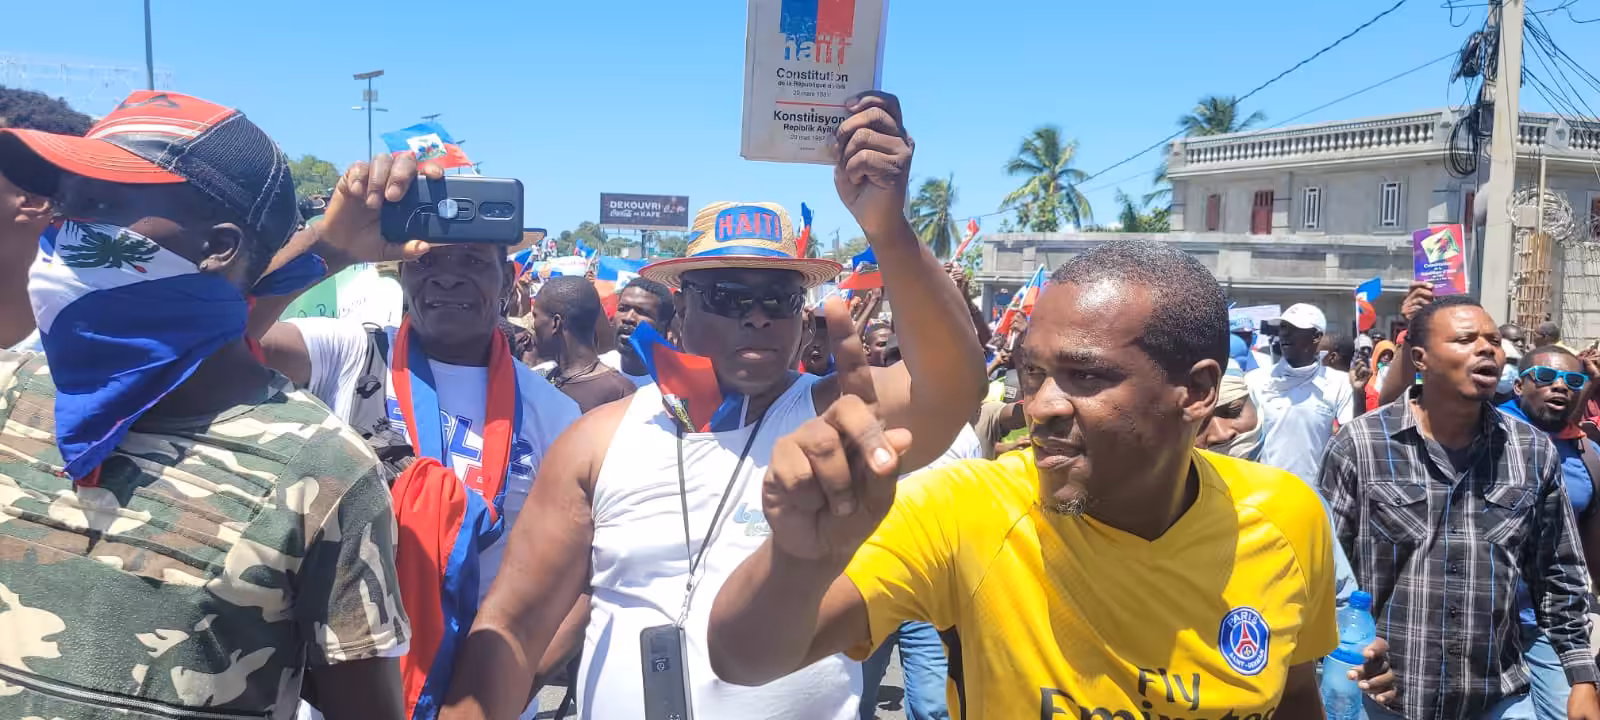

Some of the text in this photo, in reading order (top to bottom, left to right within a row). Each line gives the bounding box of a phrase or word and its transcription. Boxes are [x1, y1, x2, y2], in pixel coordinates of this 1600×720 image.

[773, 110, 846, 126] Konstitisyon
[783, 123, 816, 133] Repiblik
[609, 200, 661, 210] DEKOUVRI
[719, 212, 779, 239] HAITI
[1227, 611, 1258, 627] PARIS
[1138, 667, 1201, 711] Fly
